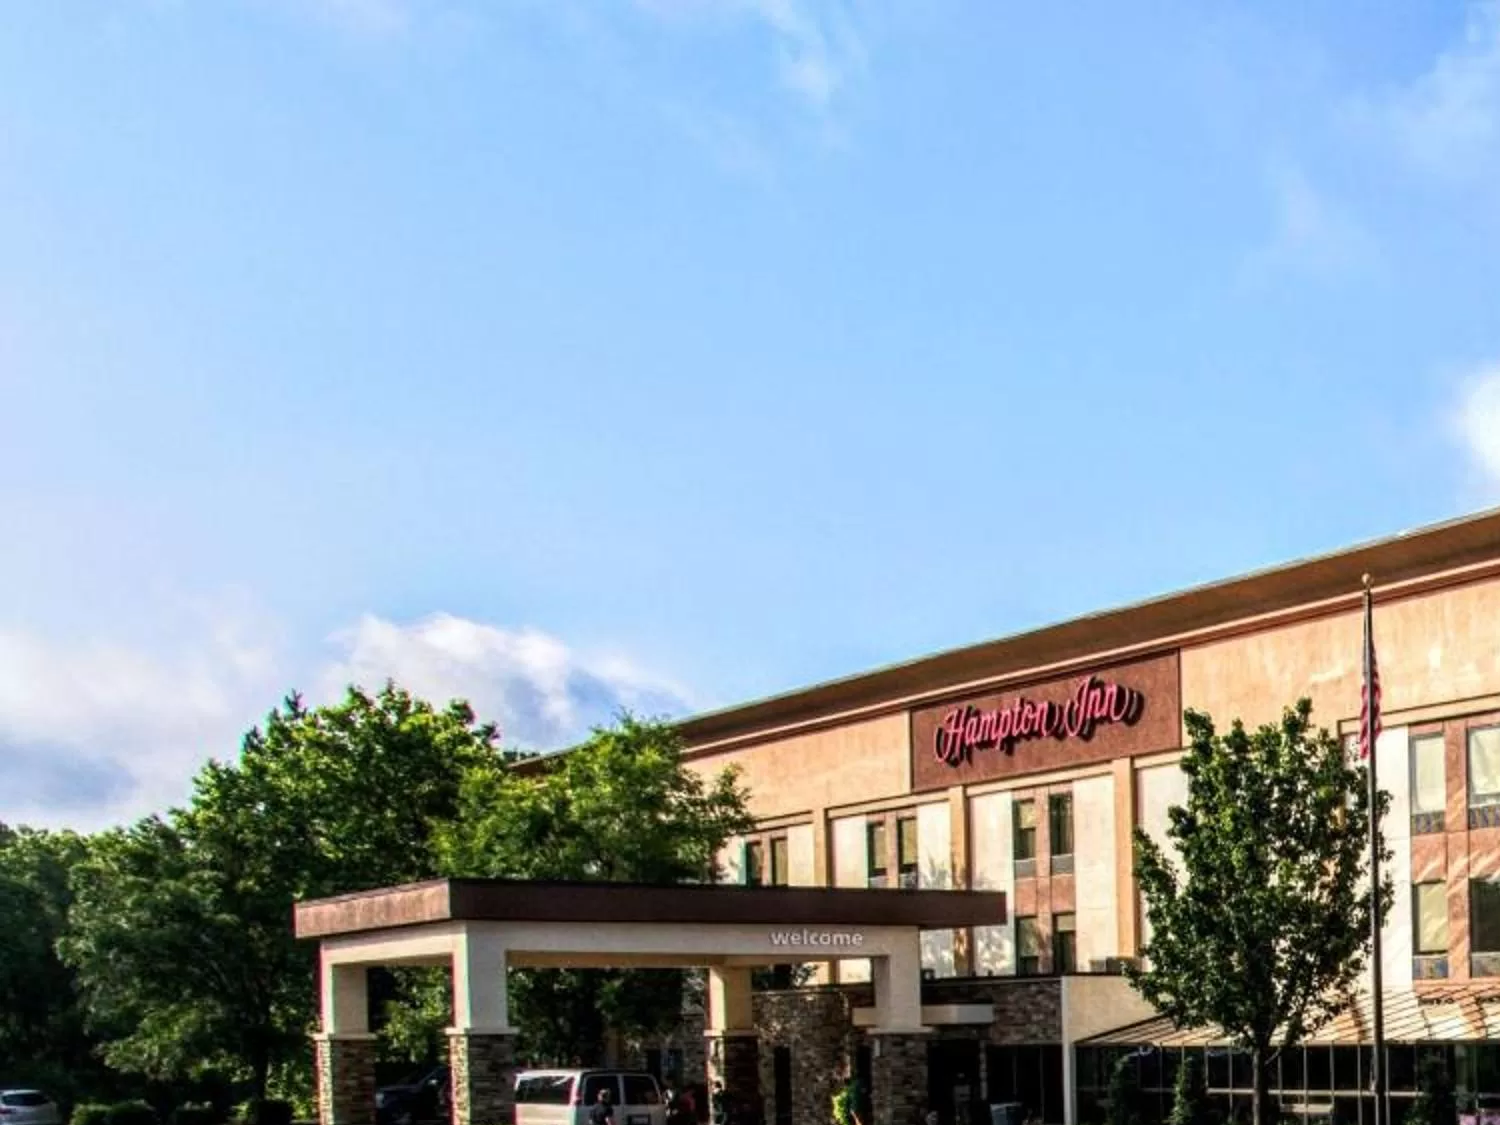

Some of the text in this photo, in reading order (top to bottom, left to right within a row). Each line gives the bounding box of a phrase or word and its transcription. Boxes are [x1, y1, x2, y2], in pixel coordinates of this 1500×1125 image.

[934, 674, 1129, 763] Hampton Inn
[770, 928, 863, 945] welcome
